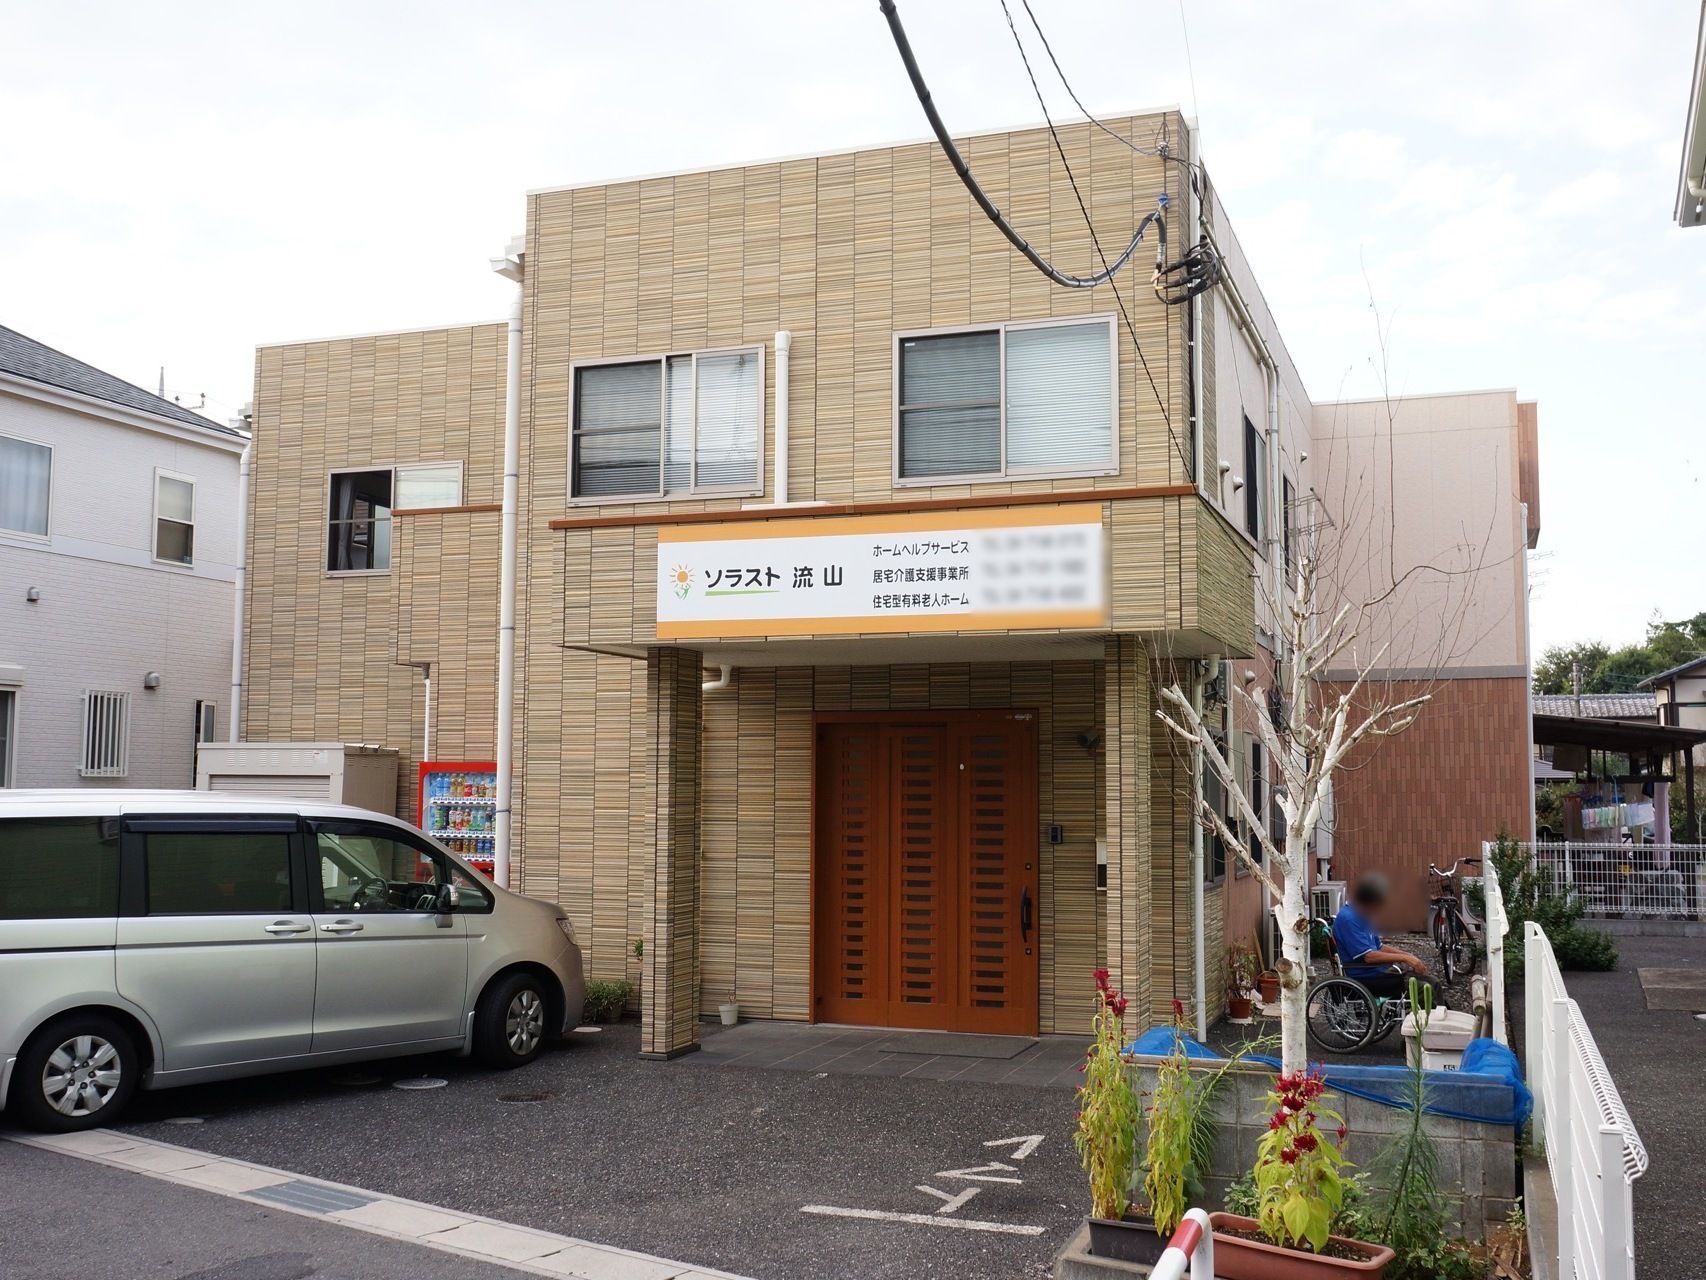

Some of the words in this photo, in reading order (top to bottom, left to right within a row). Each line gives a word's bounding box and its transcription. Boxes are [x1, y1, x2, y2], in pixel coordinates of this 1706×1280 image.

[872, 540, 970, 557] ホームヘルプサービス
[704, 566, 781, 588] ソラスト
[792, 564, 843, 588] 流山
[872, 566, 969, 583] 居宅介護支援事業所
[872, 592, 970, 608] 住宅型有料老人ホーム
